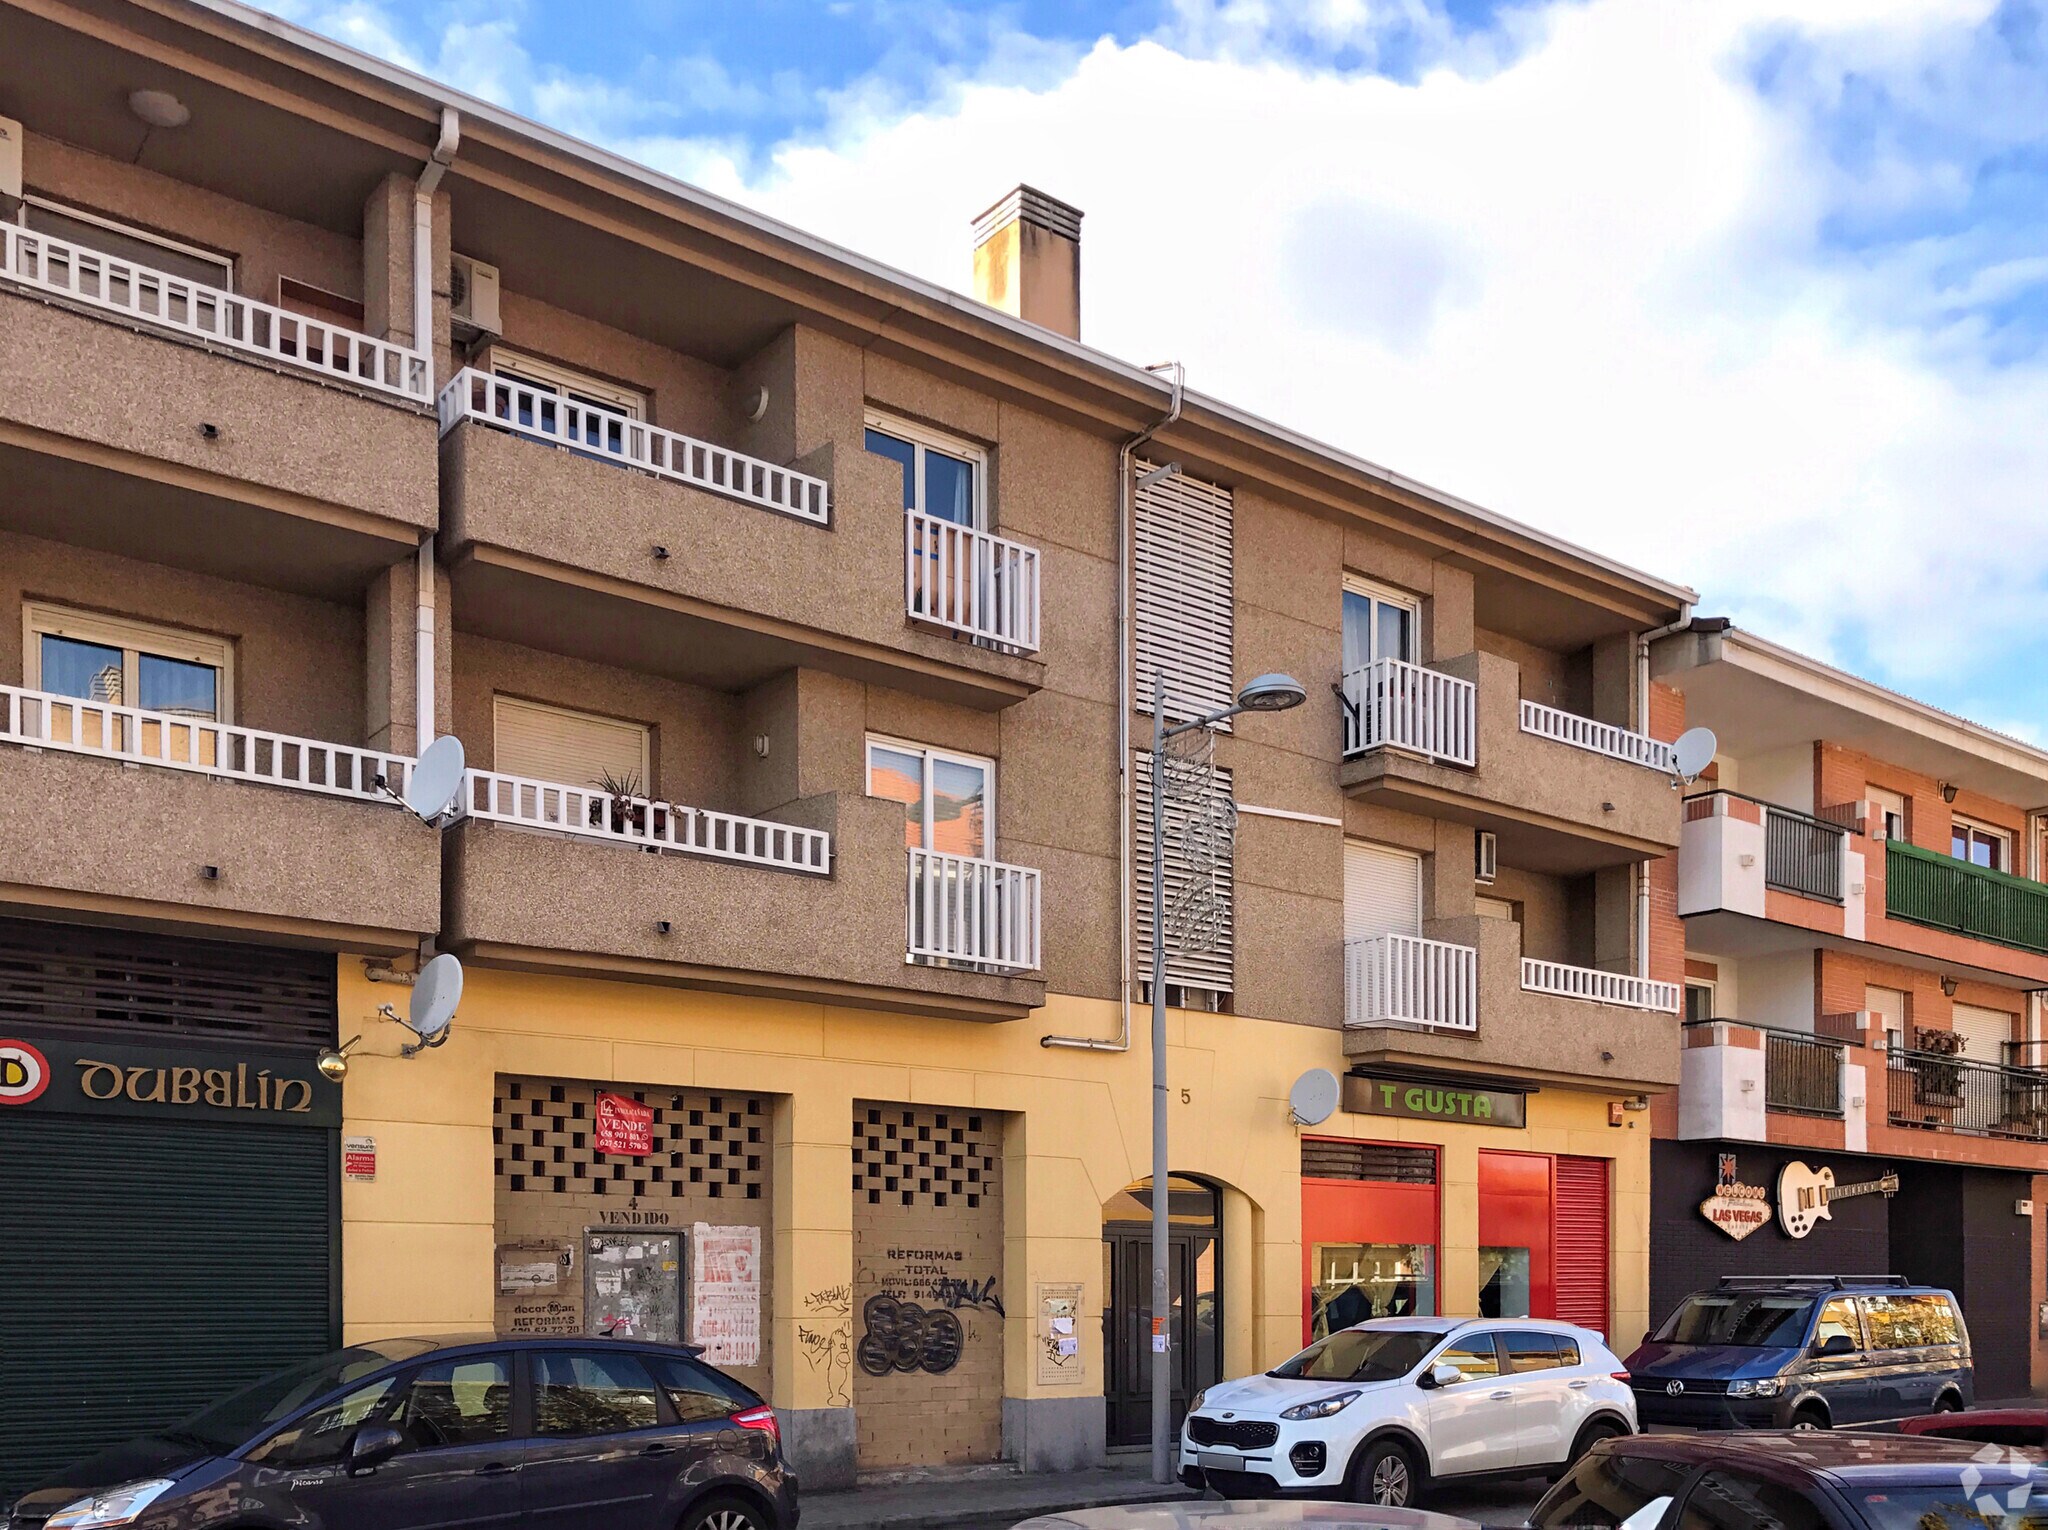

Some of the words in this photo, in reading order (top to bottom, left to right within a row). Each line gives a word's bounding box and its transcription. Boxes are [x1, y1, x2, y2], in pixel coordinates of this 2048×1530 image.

[1181, 1088, 1191, 1104] 5
[1379, 1085, 1397, 1108] T
[1404, 1088, 1492, 1119] GUSTA
[601, 1118, 647, 1132] VENDE
[613, 1140, 627, 1149] 521
[346, 1154, 375, 1162] Alarma
[1716, 1184, 1765, 1199] WELCOME
[1713, 1209, 1732, 1222] LAS
[1732, 1210, 1763, 1223] VEGAS
[887, 1249, 963, 1261] REFORMAS
[904, 1265, 948, 1275] TOTAL
[514, 1316, 575, 1327] REFORMAS
[567, 1325, 580, 1334] 20
